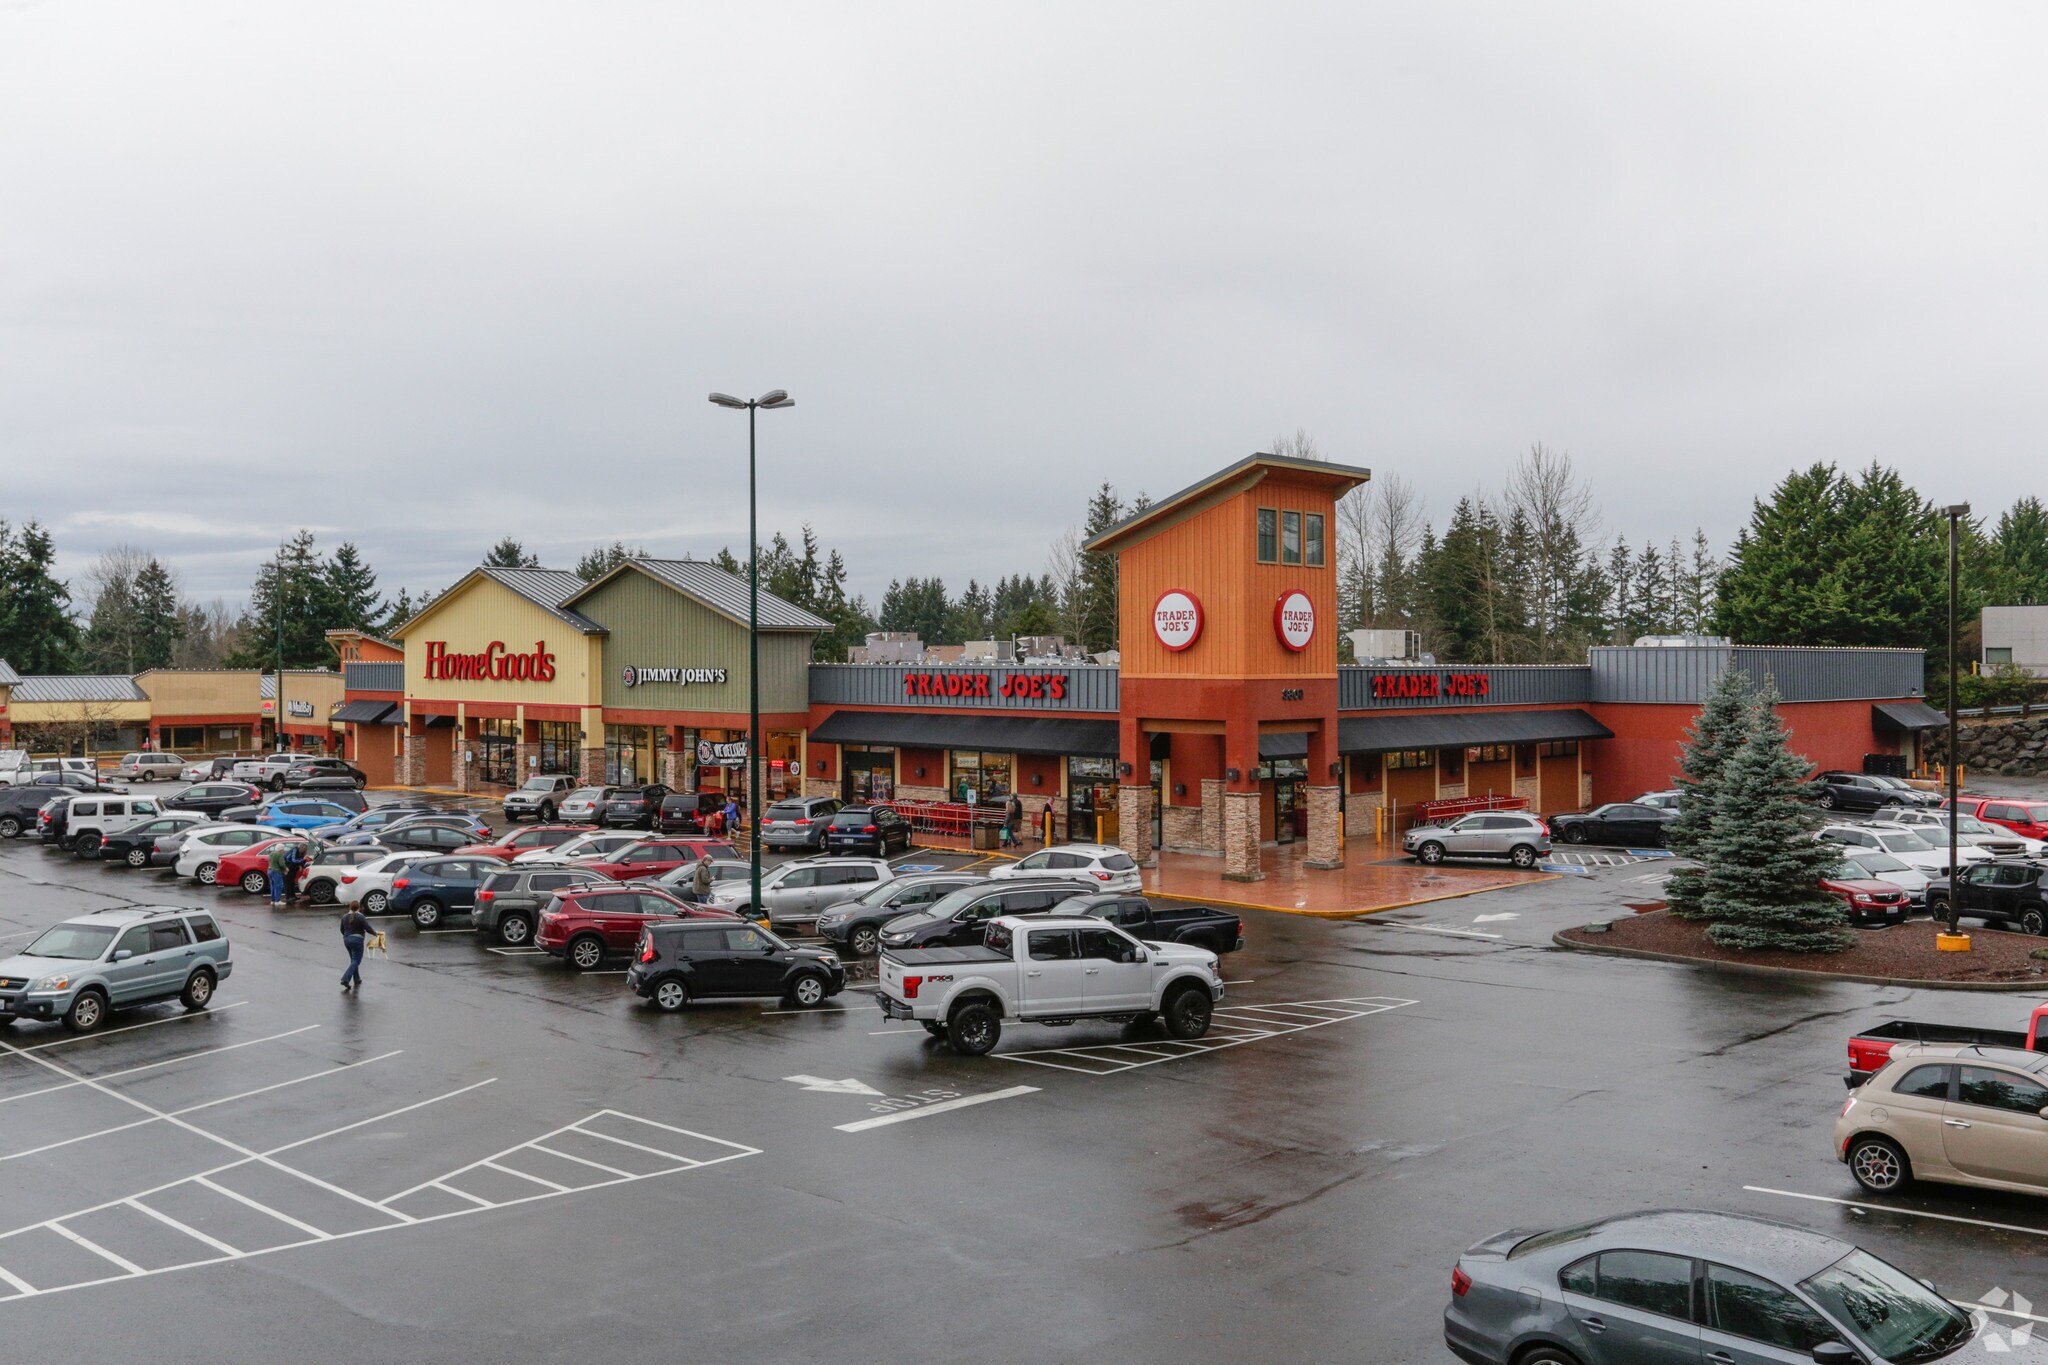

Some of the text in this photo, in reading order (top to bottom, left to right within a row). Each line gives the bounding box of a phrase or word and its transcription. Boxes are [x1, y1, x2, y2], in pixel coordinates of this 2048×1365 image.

[1157, 611, 1195, 621] TRADER
[1283, 611, 1313, 622] TRADER
[1162, 621, 1190, 632] JOE'S
[1288, 621, 1309, 633] JOE'S
[424, 640, 556, 682] HomeGoods
[637, 668, 728, 686] JIMMY JOHN'S
[904, 673, 1068, 700] TRADER JOE'S
[1373, 674, 1489, 698] TRADER JOE'S
[927, 975, 954, 983] FX4
